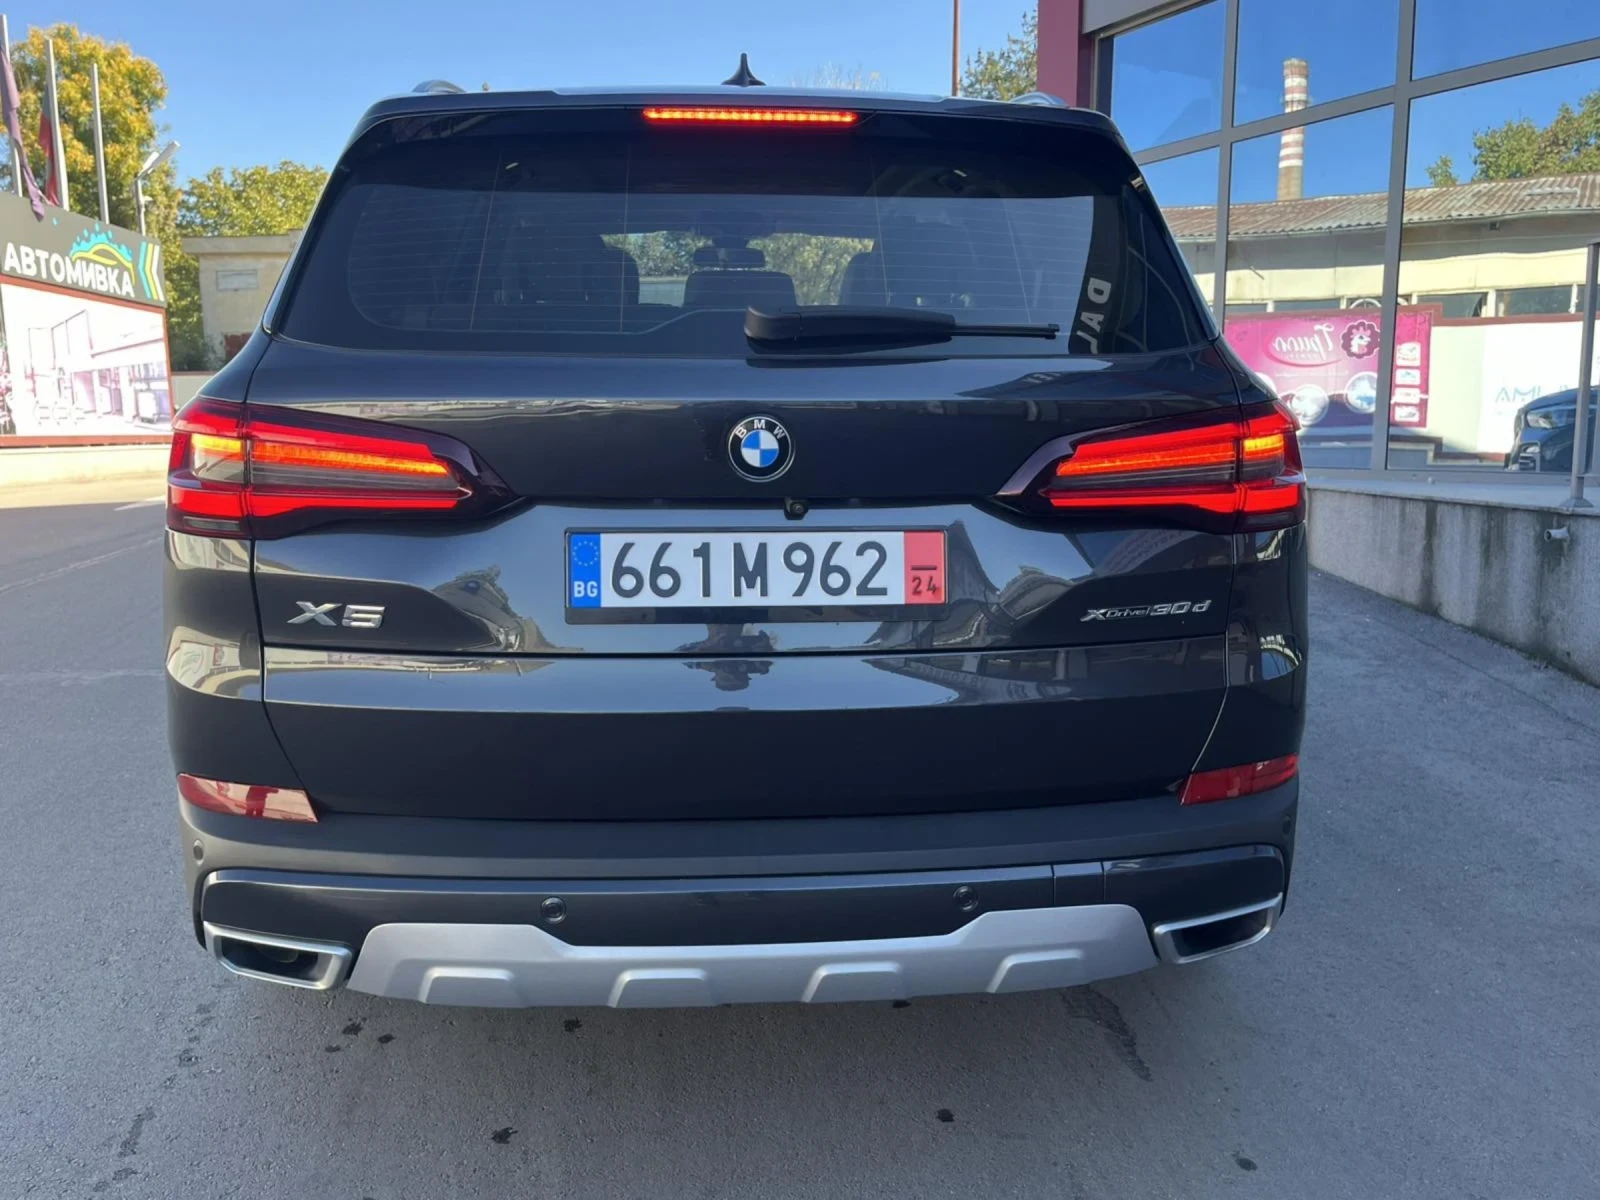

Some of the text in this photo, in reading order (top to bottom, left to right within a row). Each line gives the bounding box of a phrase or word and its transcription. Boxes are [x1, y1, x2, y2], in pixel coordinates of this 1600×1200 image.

[4, 242, 136, 298] АВТОМИВКА
[735, 419, 787, 440] BMW
[574, 580, 599, 599] BG
[910, 575, 940, 596] 24
[286, 601, 386, 629] X5
